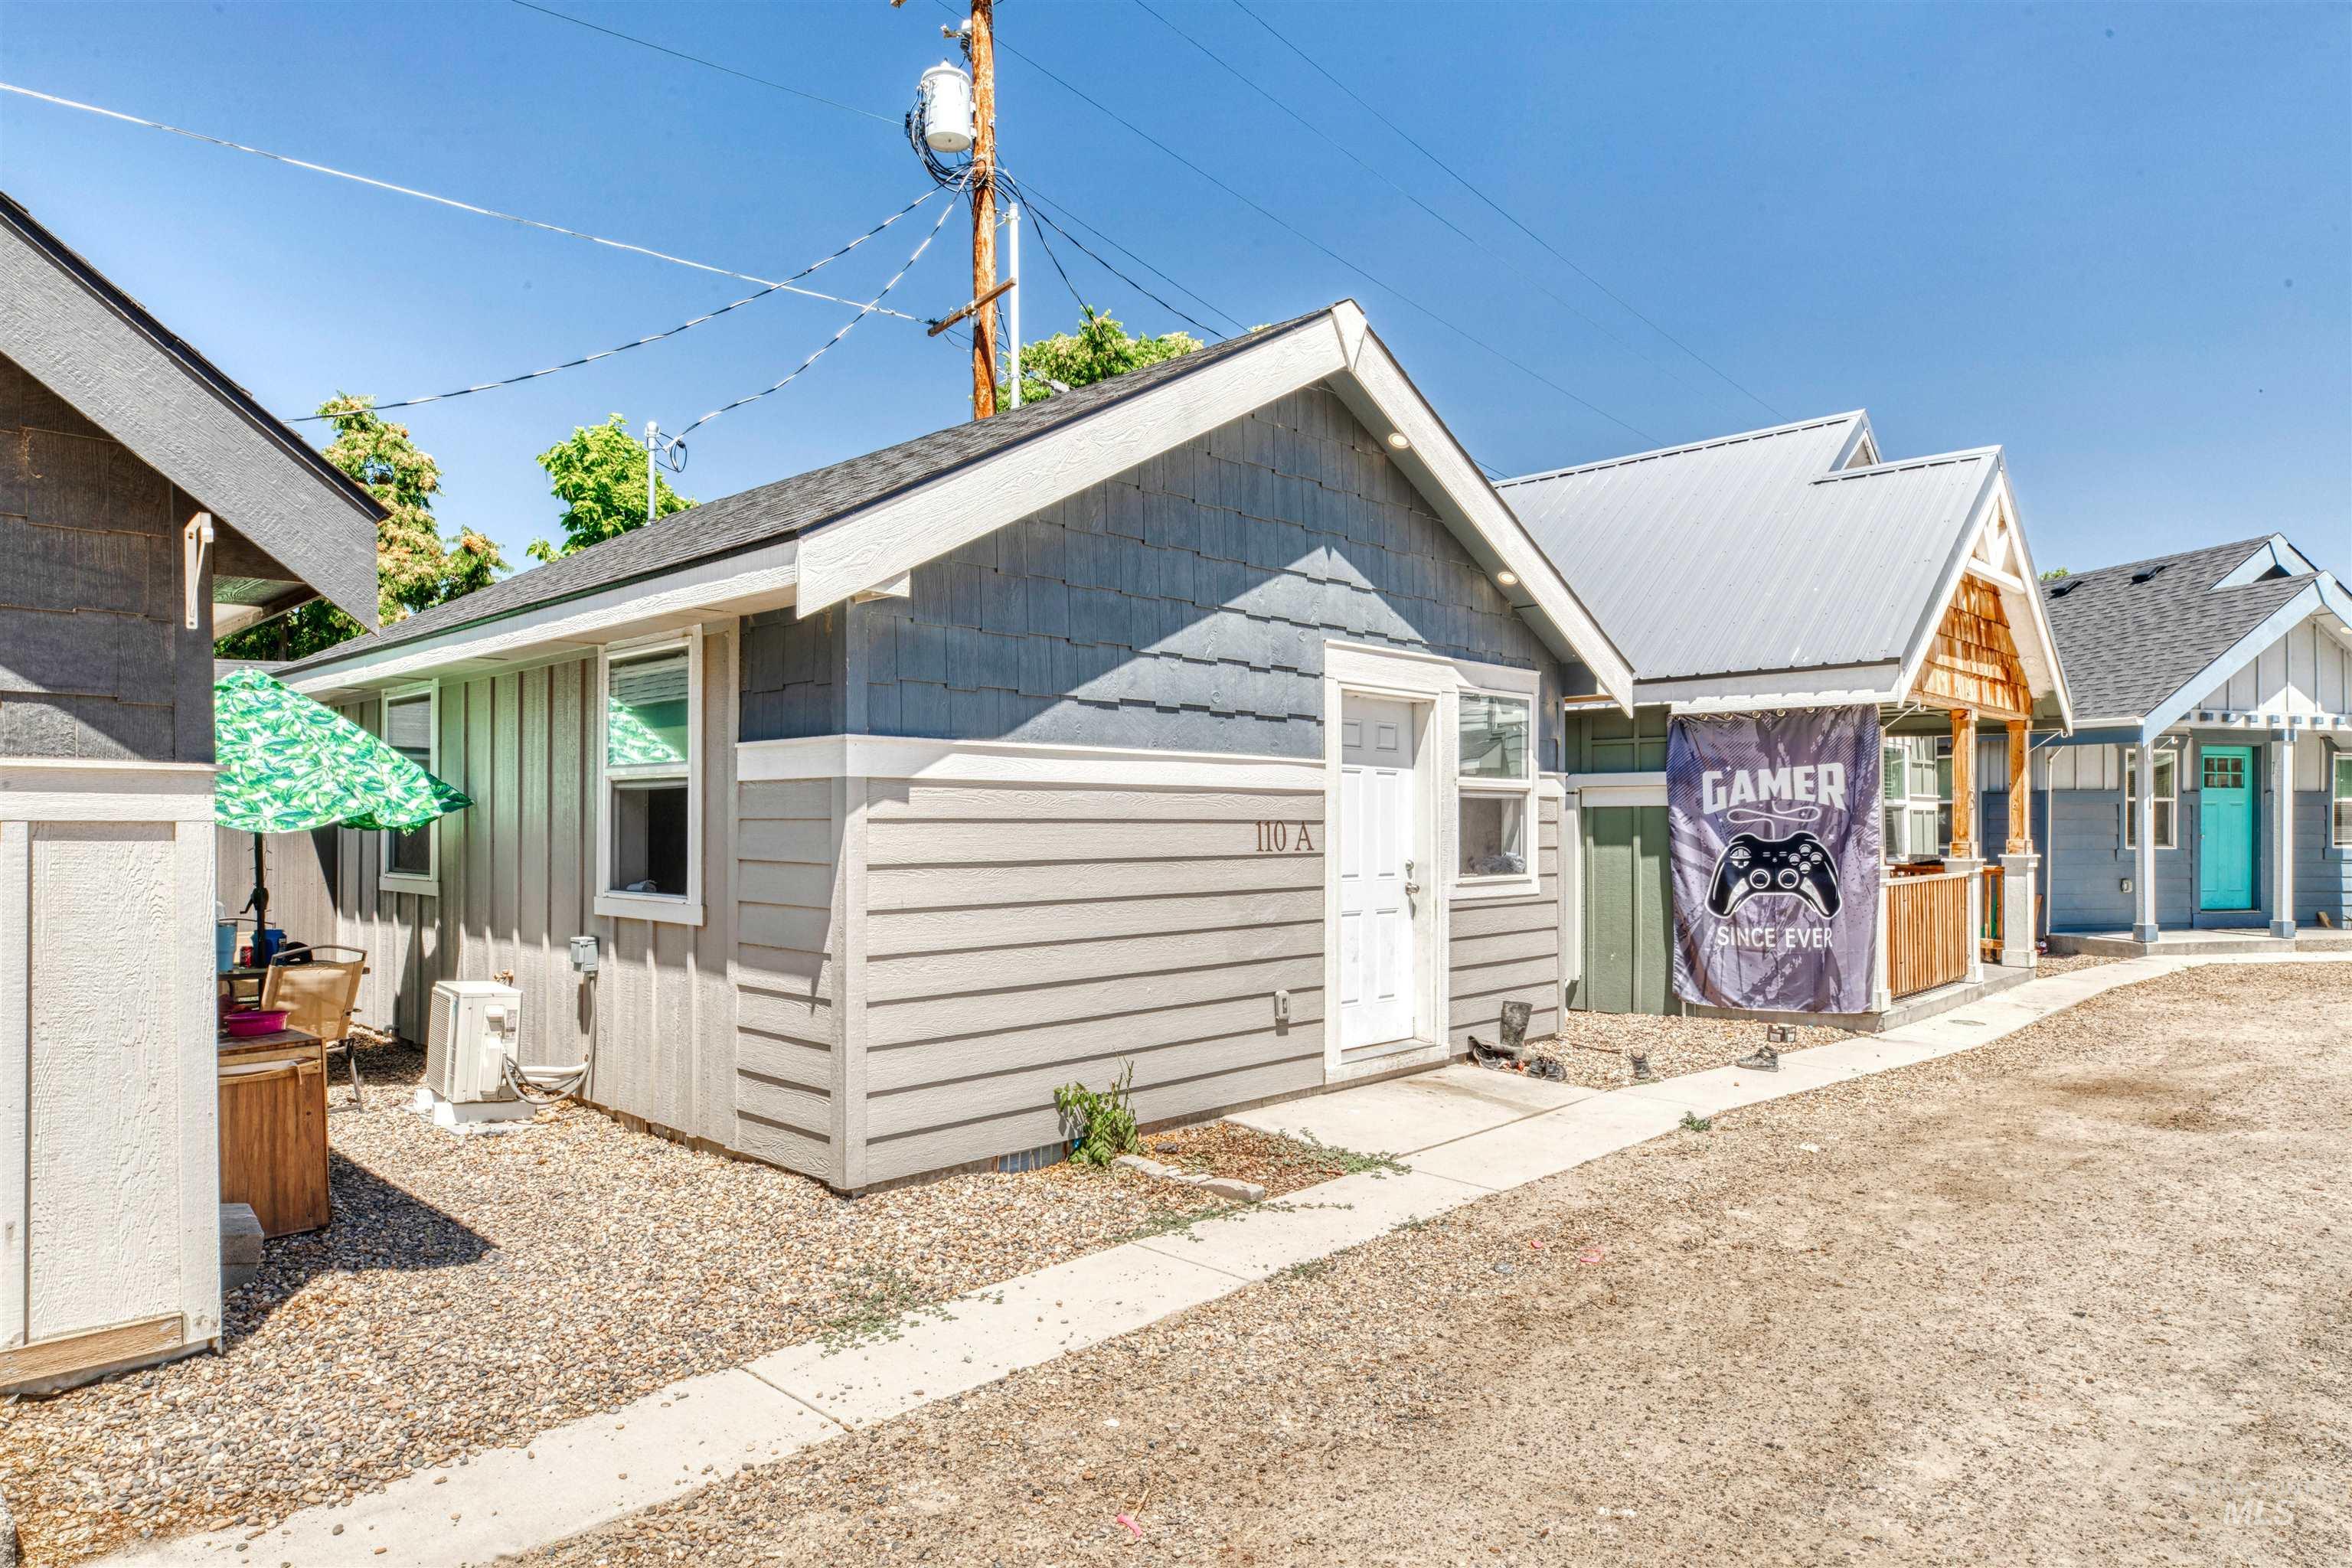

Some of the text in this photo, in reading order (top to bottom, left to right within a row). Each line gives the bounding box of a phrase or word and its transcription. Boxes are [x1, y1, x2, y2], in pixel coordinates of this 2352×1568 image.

[1702, 763, 1847, 815] GAMER
[1256, 820, 1315, 851] 110 A
[1717, 926, 1833, 948] SINCE EVER
